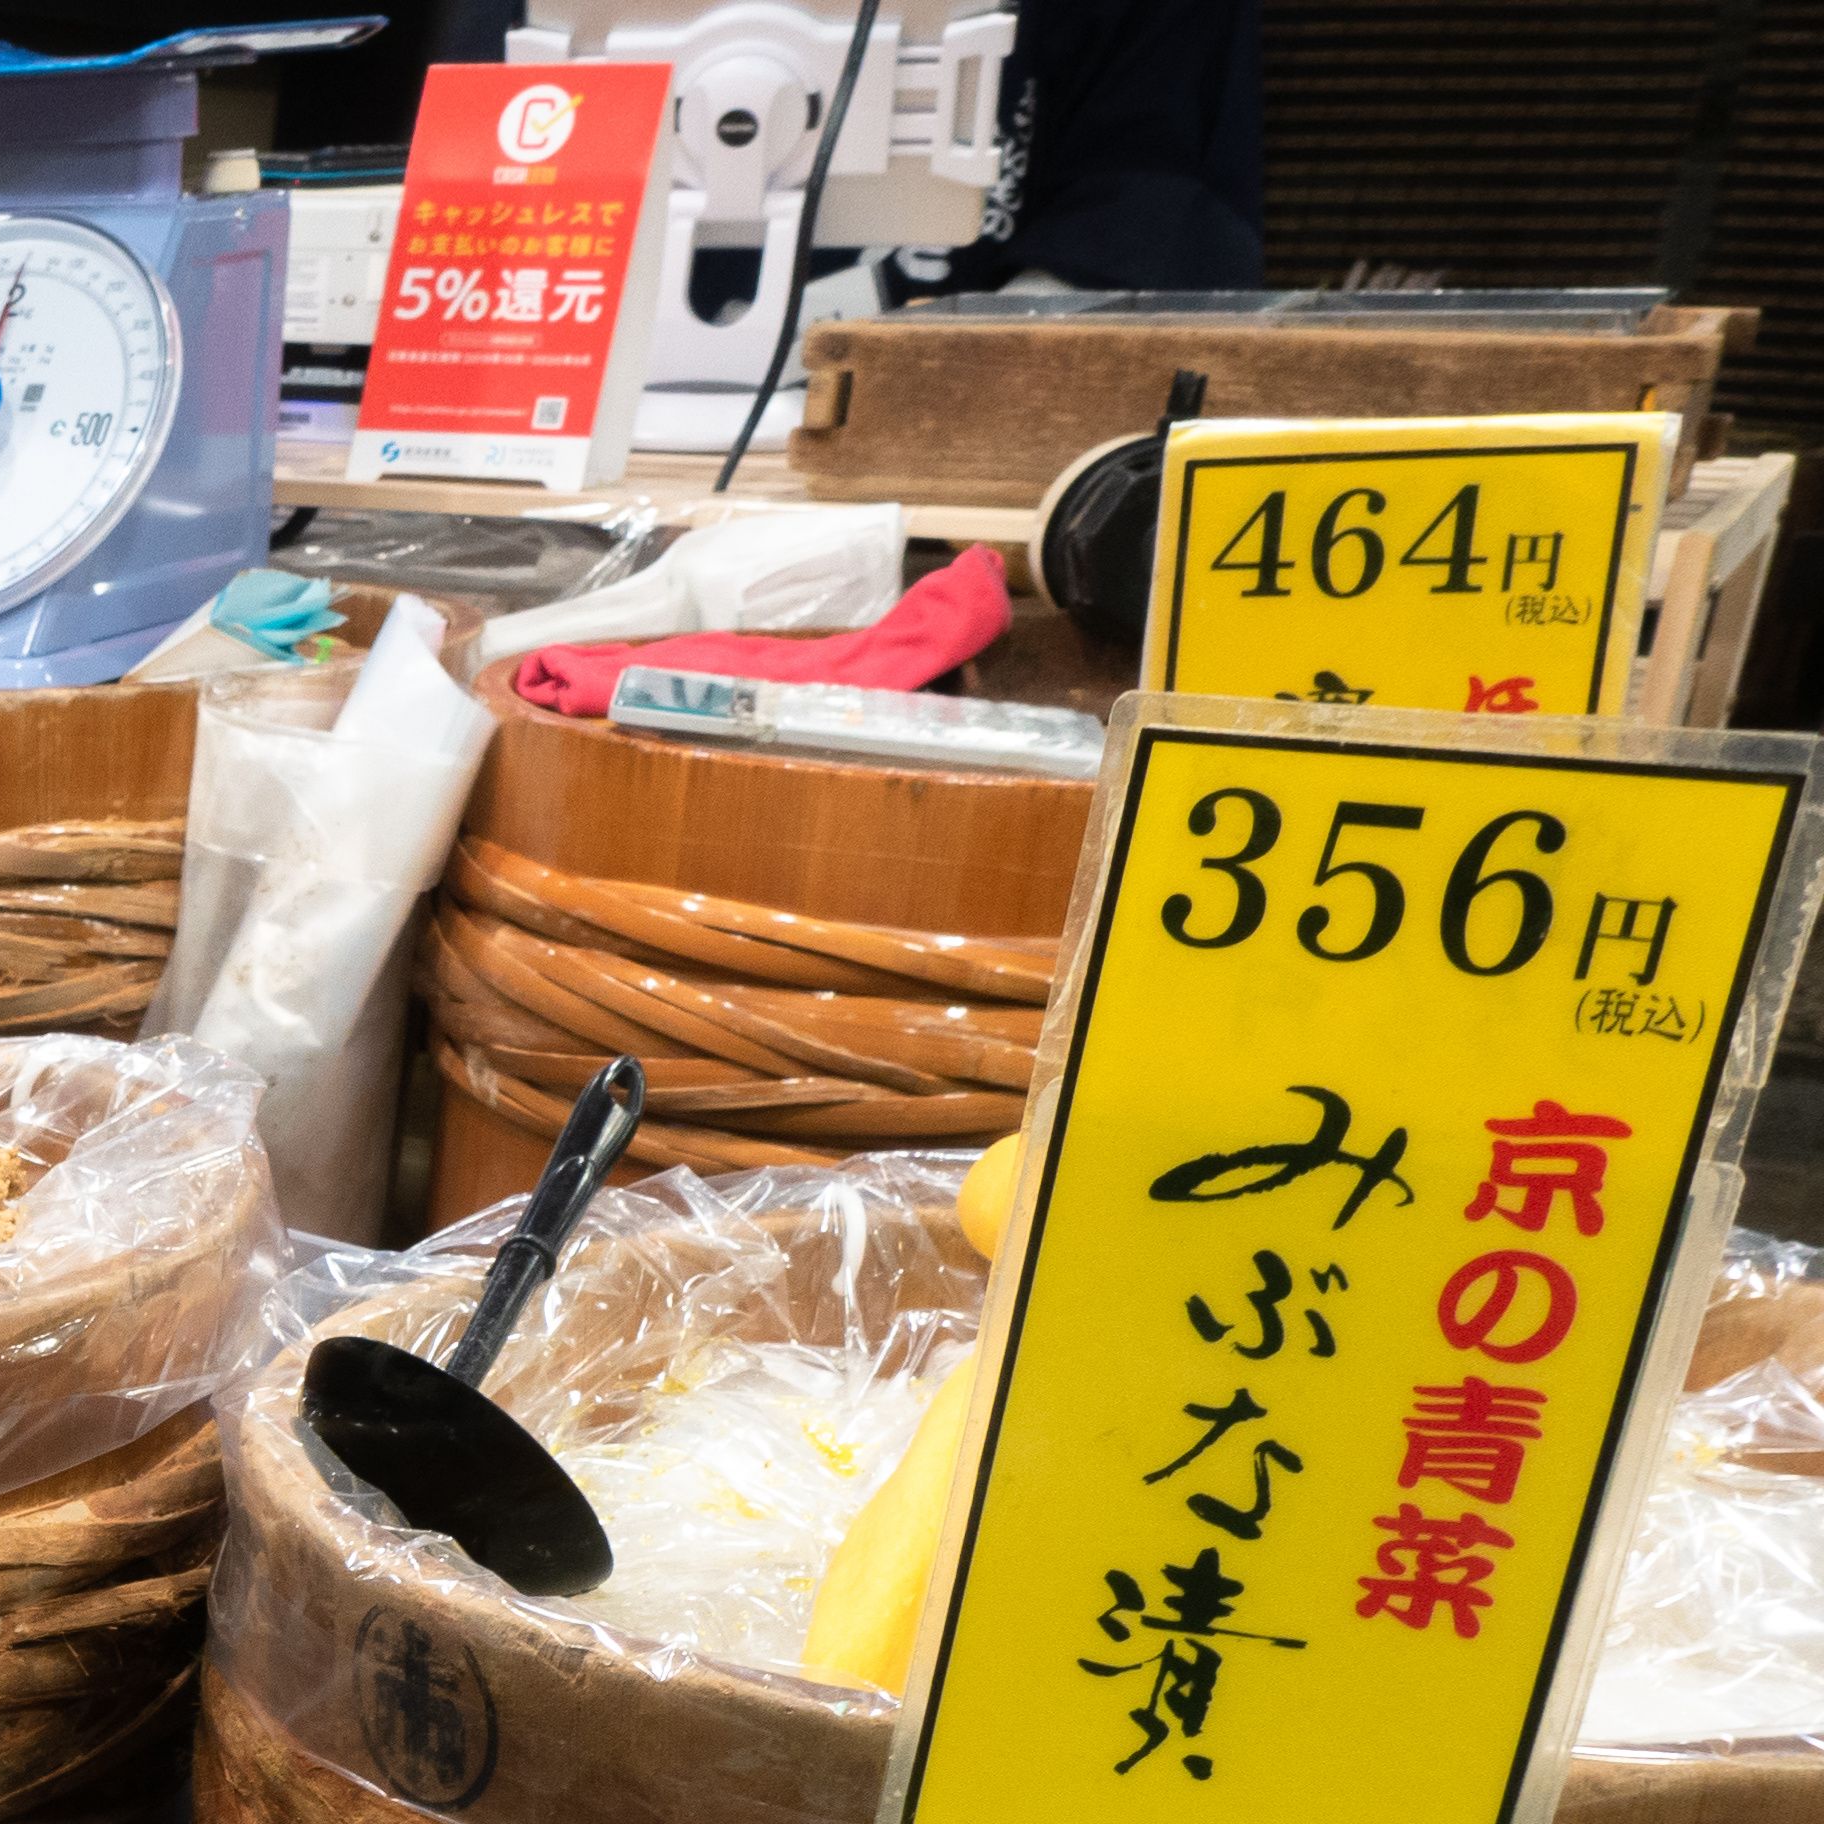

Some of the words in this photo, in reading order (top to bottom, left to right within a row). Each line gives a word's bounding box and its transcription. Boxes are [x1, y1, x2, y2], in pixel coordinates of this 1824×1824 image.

[414, 200, 624, 226] キャッシュレスで
[393, 267, 606, 323] 5%還元
[1209, 483, 1565, 600] 464円
[1503, 596, 1594, 626] (税込)
[1159, 786, 1679, 987] 356円
[1573, 987, 1709, 1046] (税込)
[1355, 1099, 1634, 1640] 京の青菜
[1076, 1084, 1415, 1782] みぶな漬
